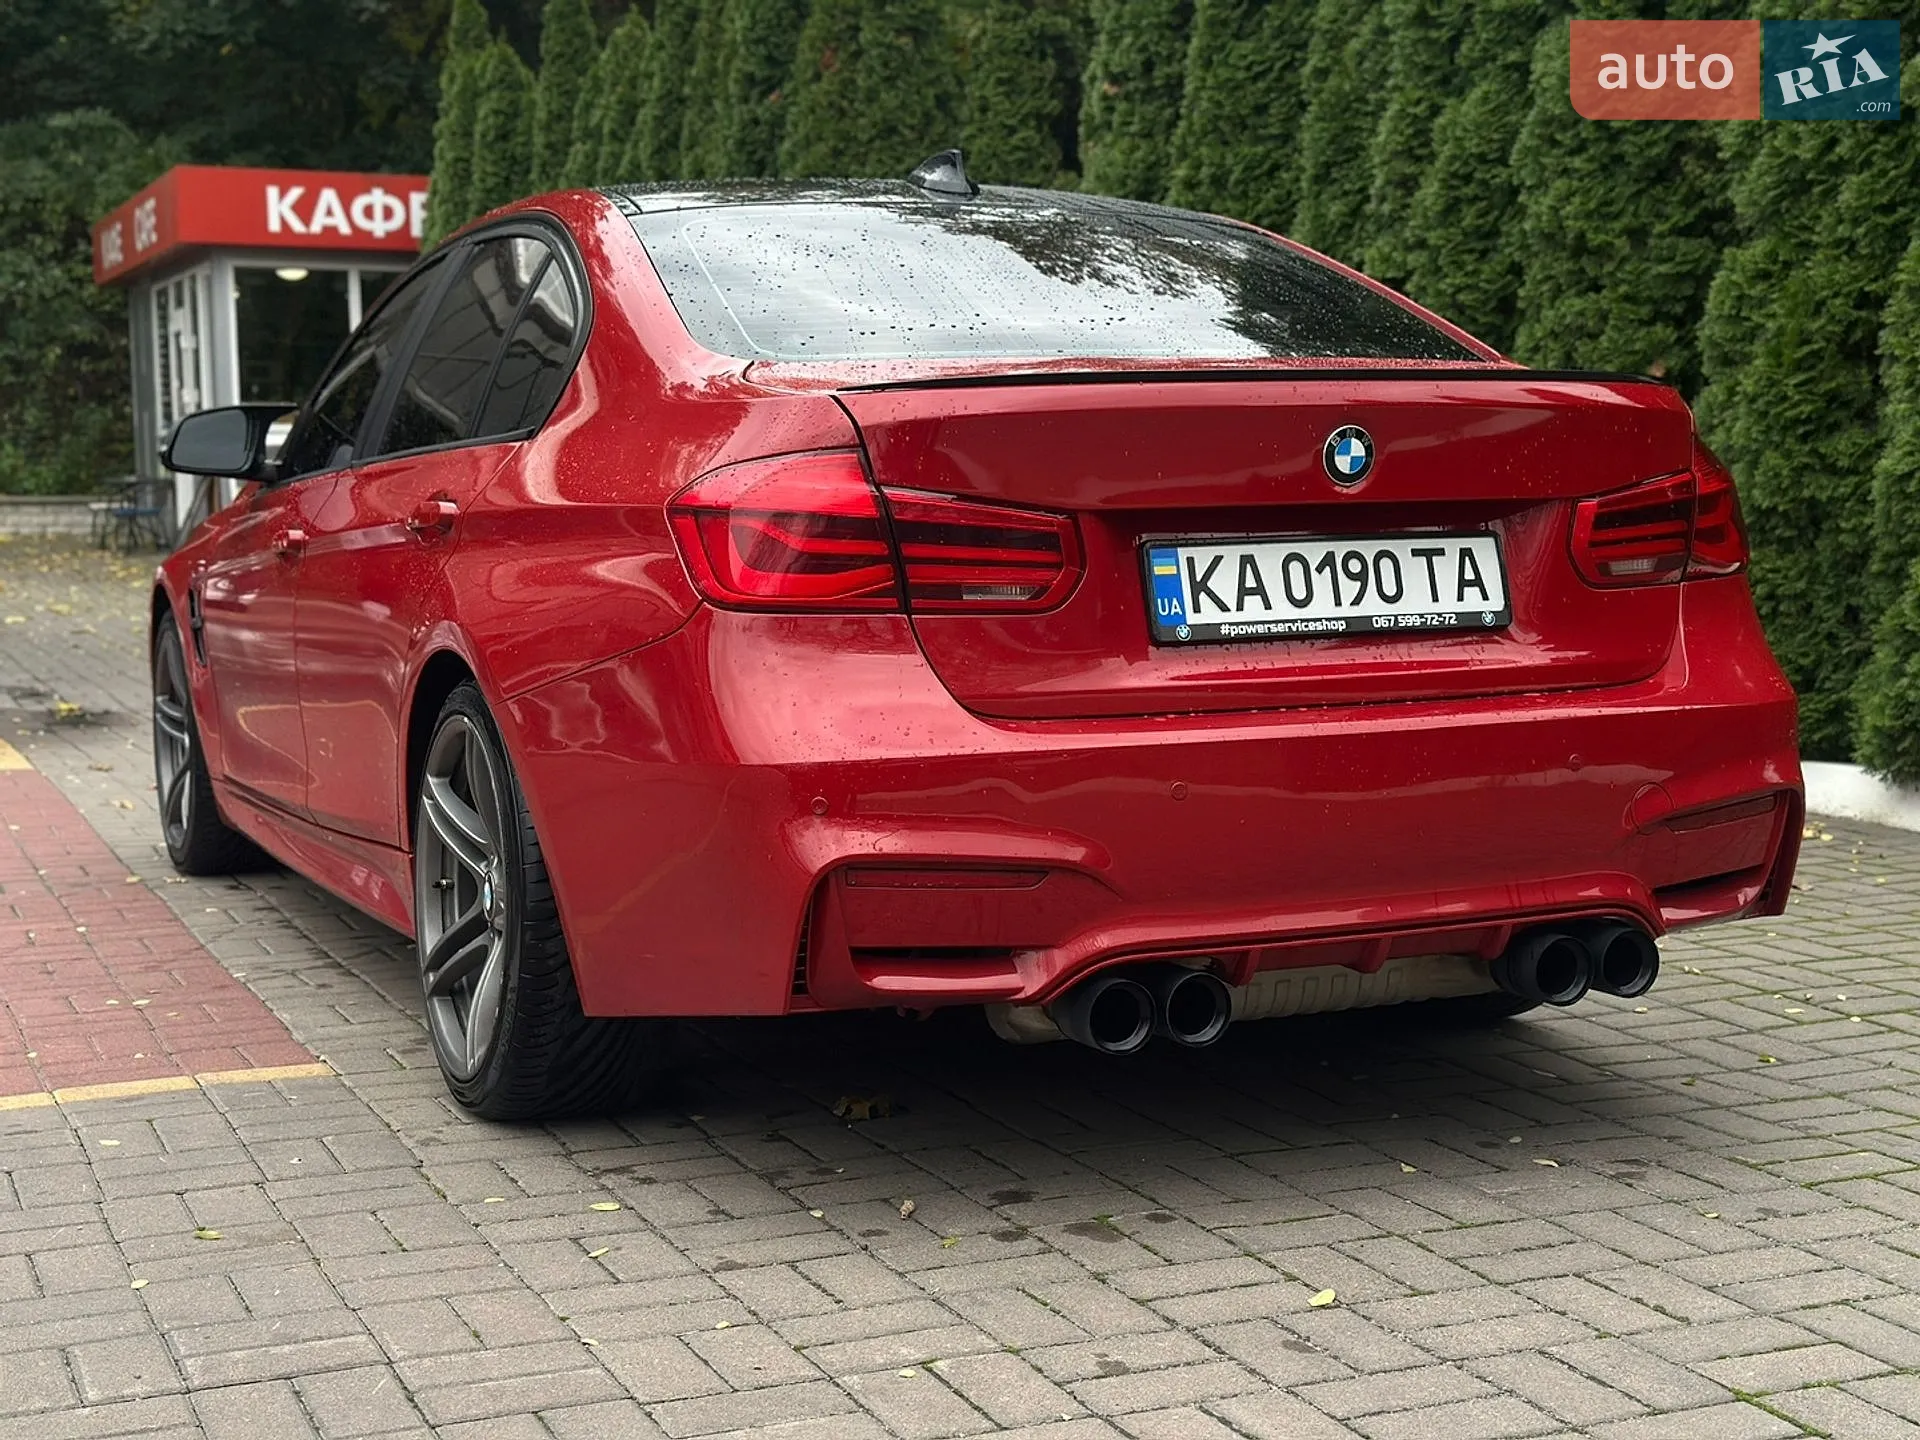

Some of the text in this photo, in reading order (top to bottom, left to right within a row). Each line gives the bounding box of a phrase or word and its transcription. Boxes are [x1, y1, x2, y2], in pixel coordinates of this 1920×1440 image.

[1330, 428, 1371, 447] BMW
[1186, 547, 1490, 613] KA 0190 TA
[1158, 597, 1183, 616] UA
[1220, 619, 1346, 637] #powerserviceshop
[1372, 613, 1458, 628] 067 599-72-72
